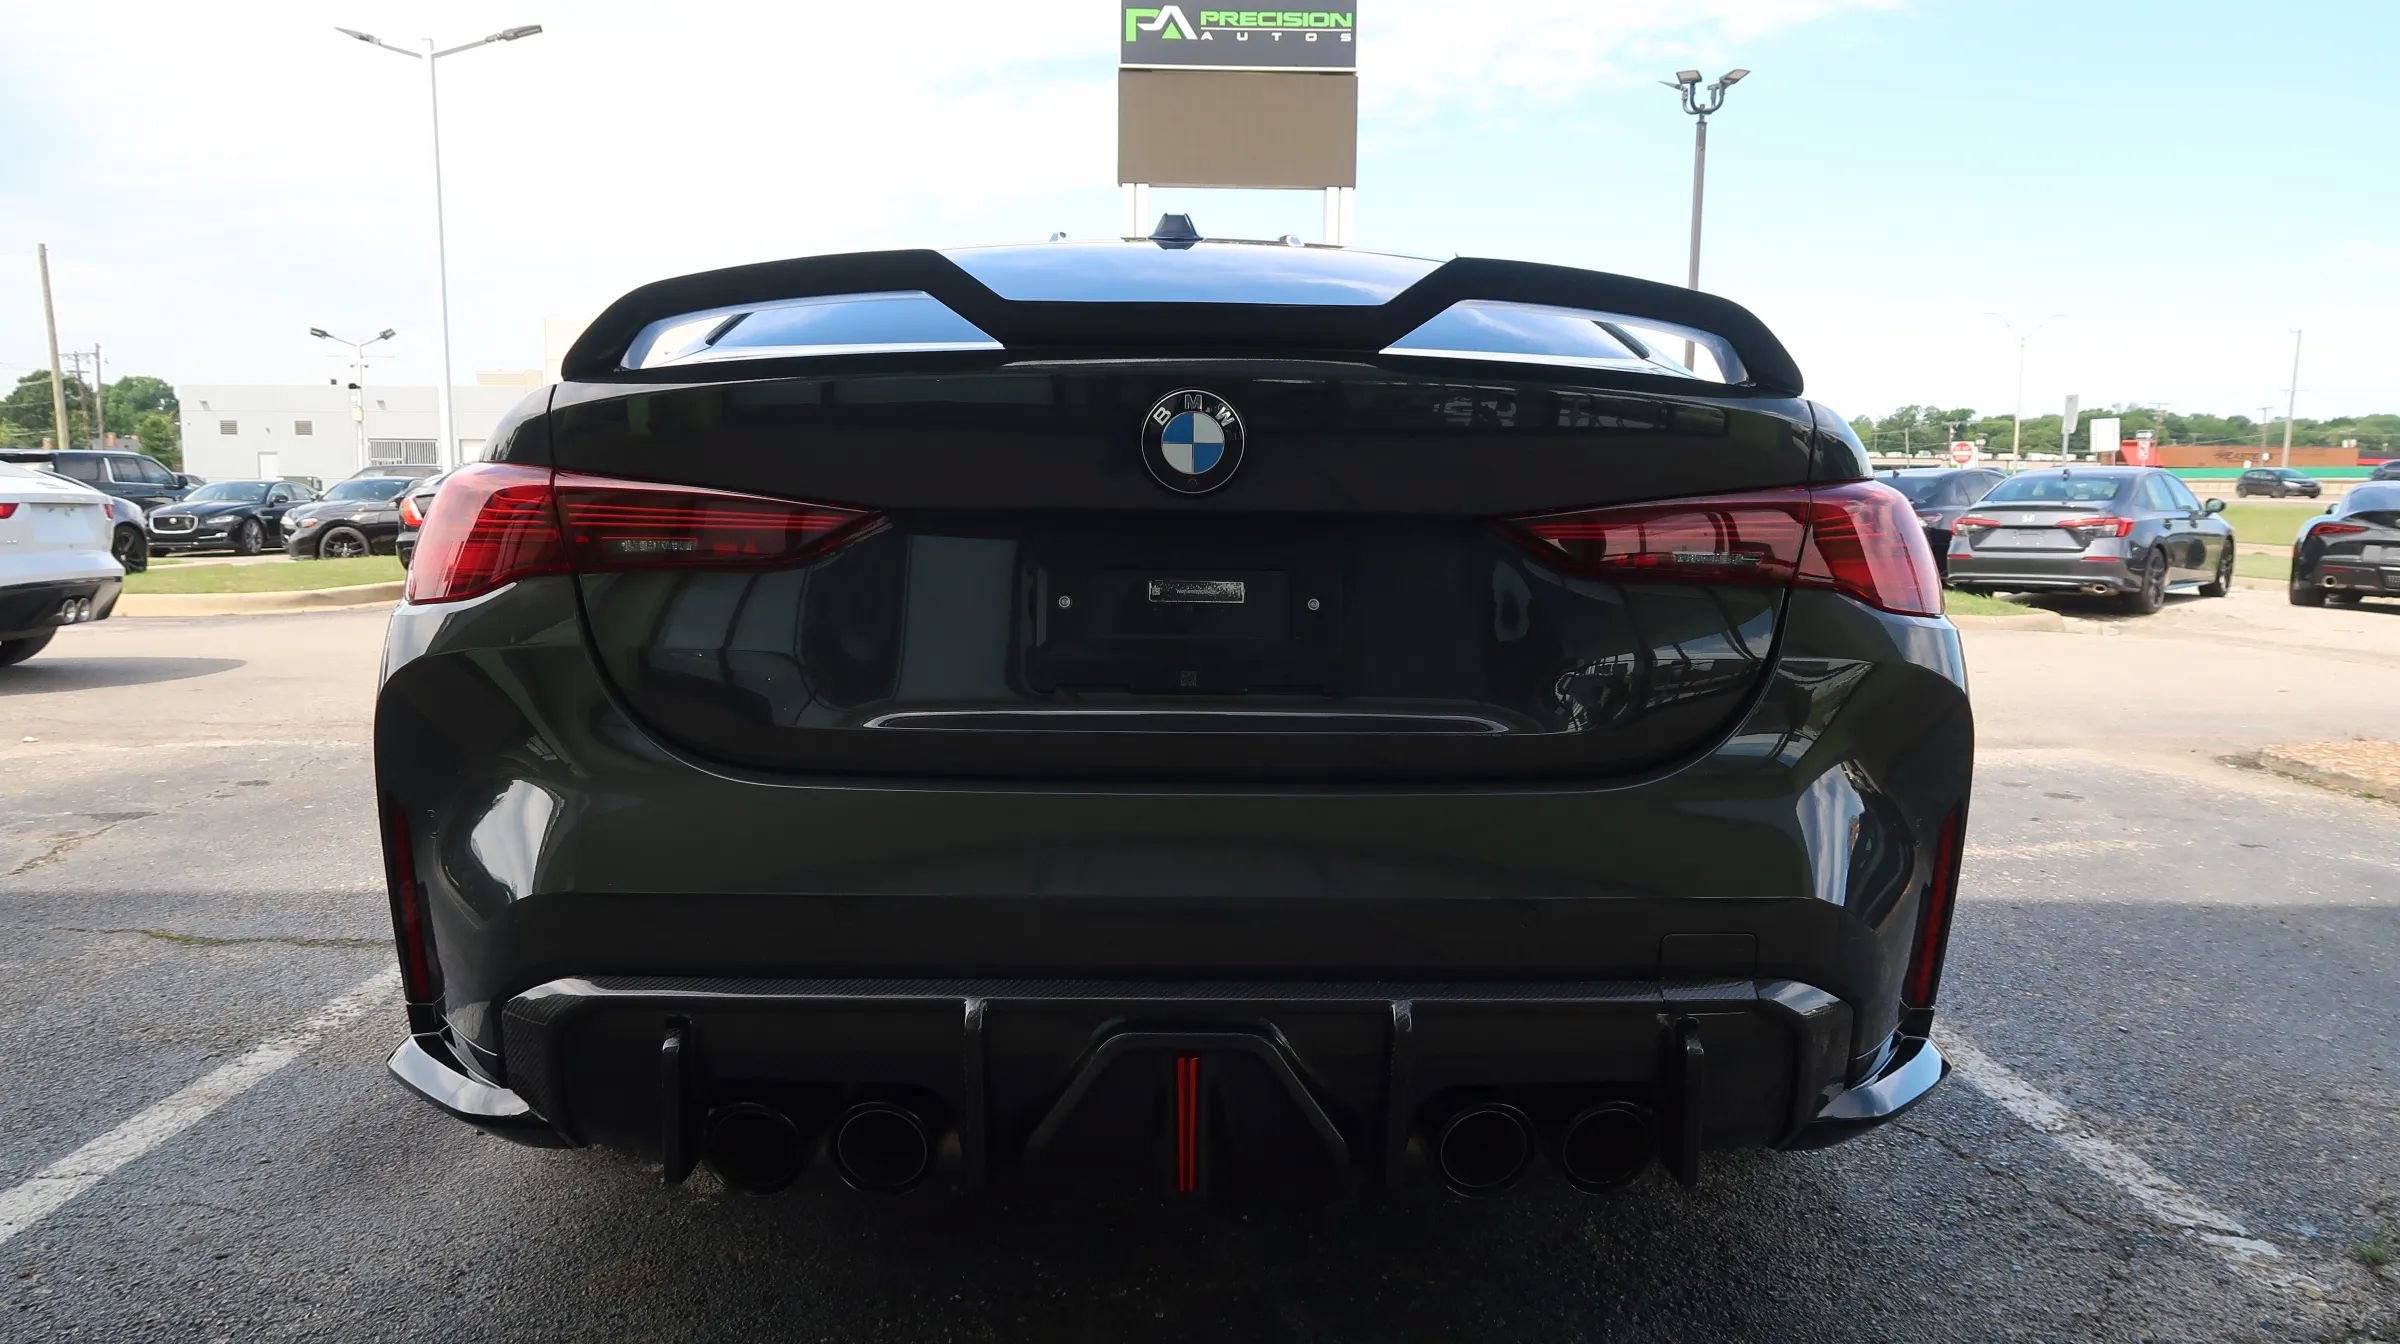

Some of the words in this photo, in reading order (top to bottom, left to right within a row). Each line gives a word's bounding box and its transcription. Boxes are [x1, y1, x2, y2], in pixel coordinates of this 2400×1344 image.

[1200, 11, 1353, 28] PRECISION
[1200, 31, 1352, 42] AUTOS
[1152, 393, 1235, 427] BMW
